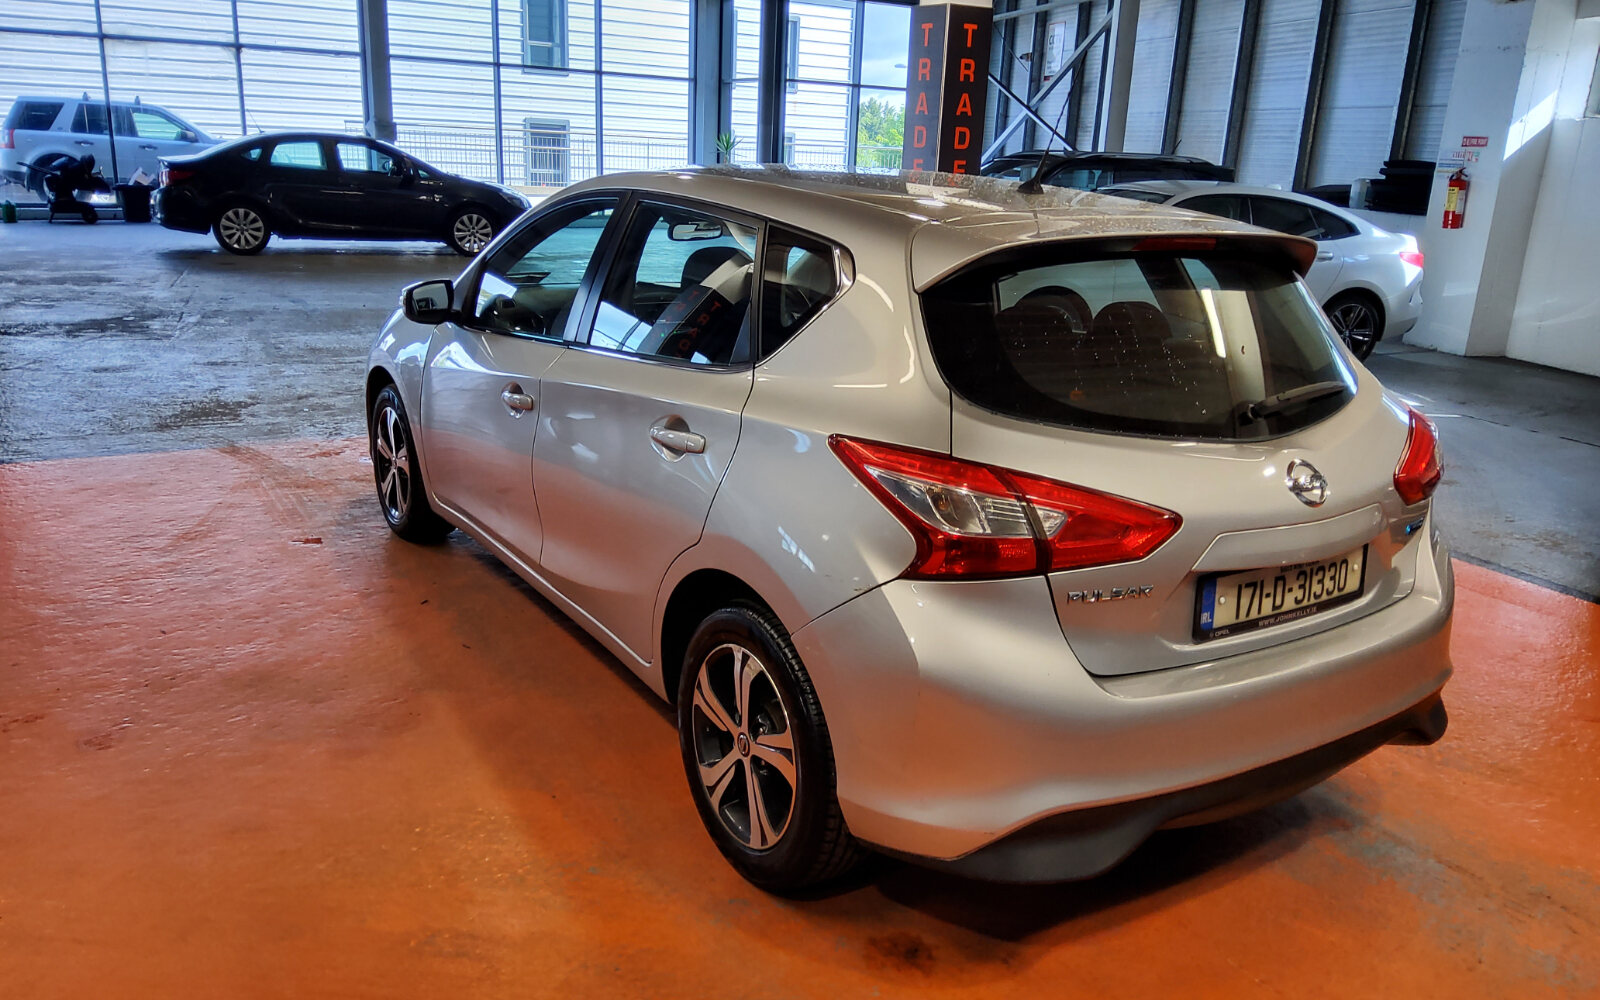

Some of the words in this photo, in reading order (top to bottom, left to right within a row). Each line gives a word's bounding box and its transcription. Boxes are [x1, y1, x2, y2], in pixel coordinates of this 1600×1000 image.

[1067, 584, 1153, 604] PULSAR
[1234, 558, 1349, 620] 171-D-31330
[1200, 611, 1212, 624] IRL
